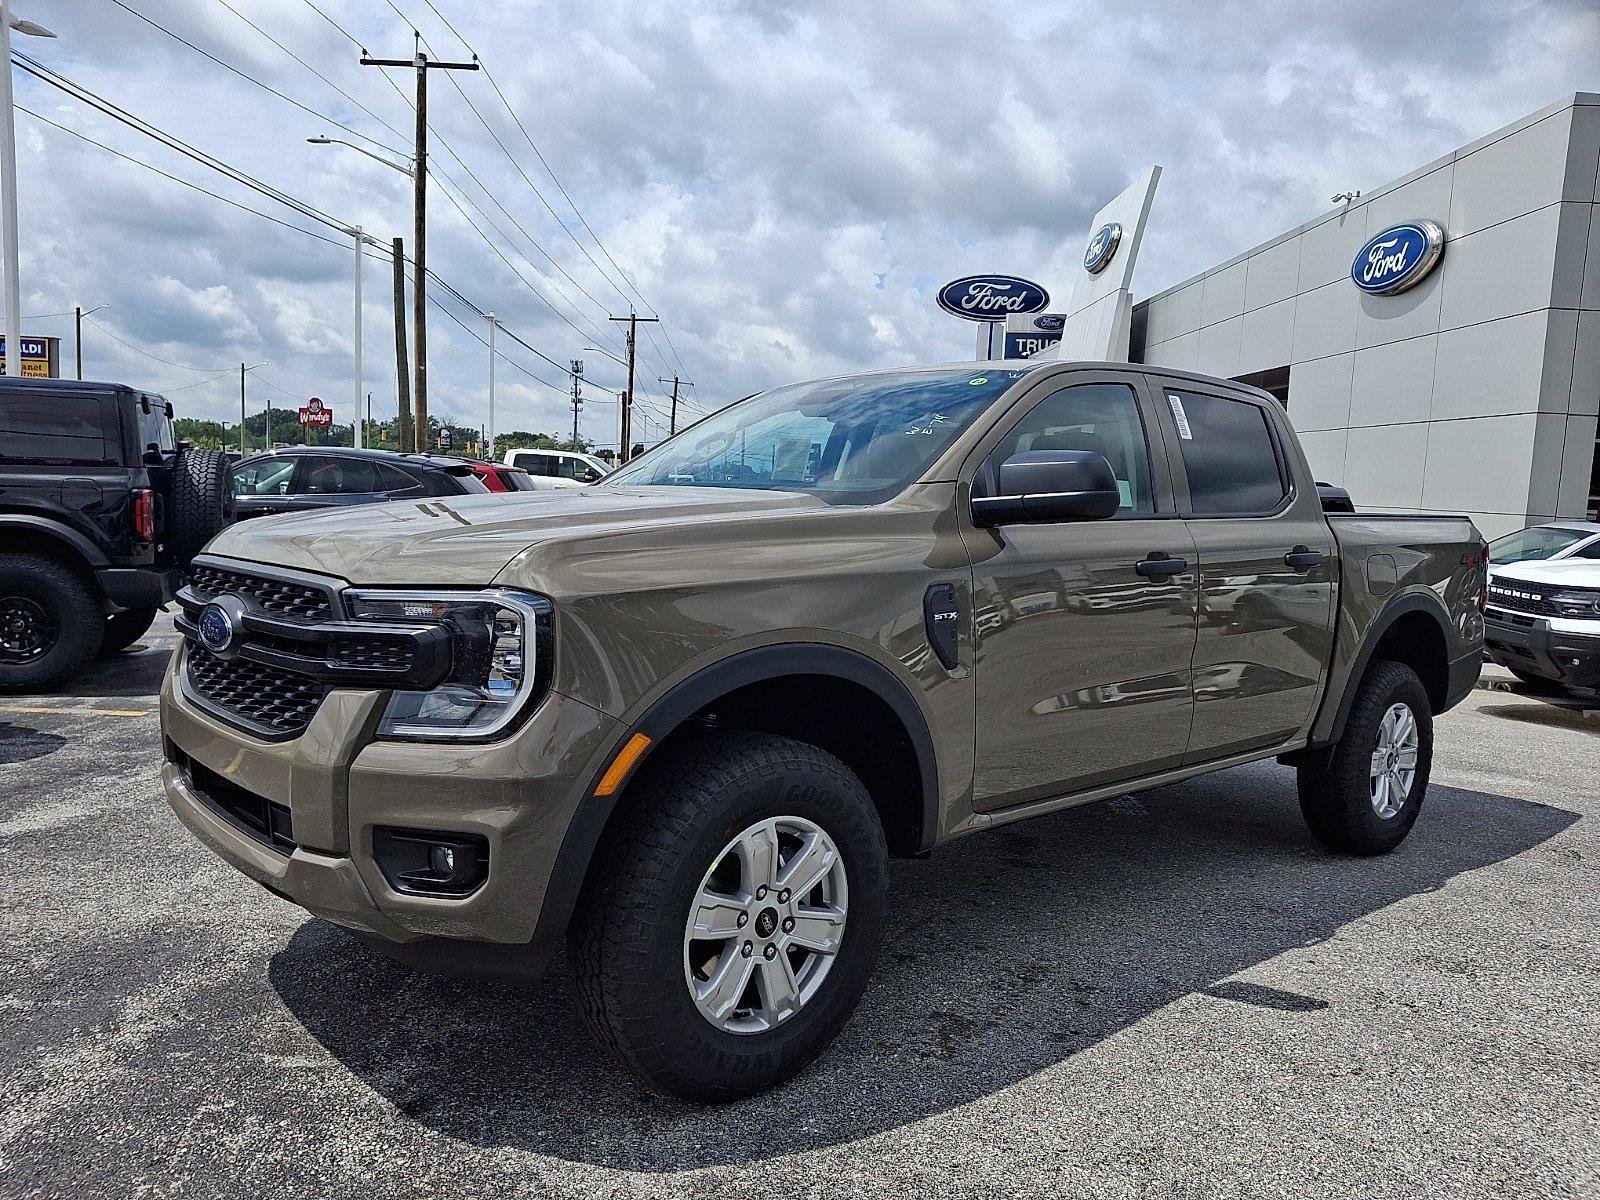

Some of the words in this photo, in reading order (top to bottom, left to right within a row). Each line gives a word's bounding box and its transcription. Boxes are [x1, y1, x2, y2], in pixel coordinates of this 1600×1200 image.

[1364, 238, 1409, 282] Ford
[961, 282, 1028, 310] Ford
[1041, 317, 1061, 327] Ford
[20, 344, 42, 354] LDI
[300, 411, 330, 424] Wendy's
[1490, 586, 1542, 601] BRONCO
[934, 611, 959, 621] STX
